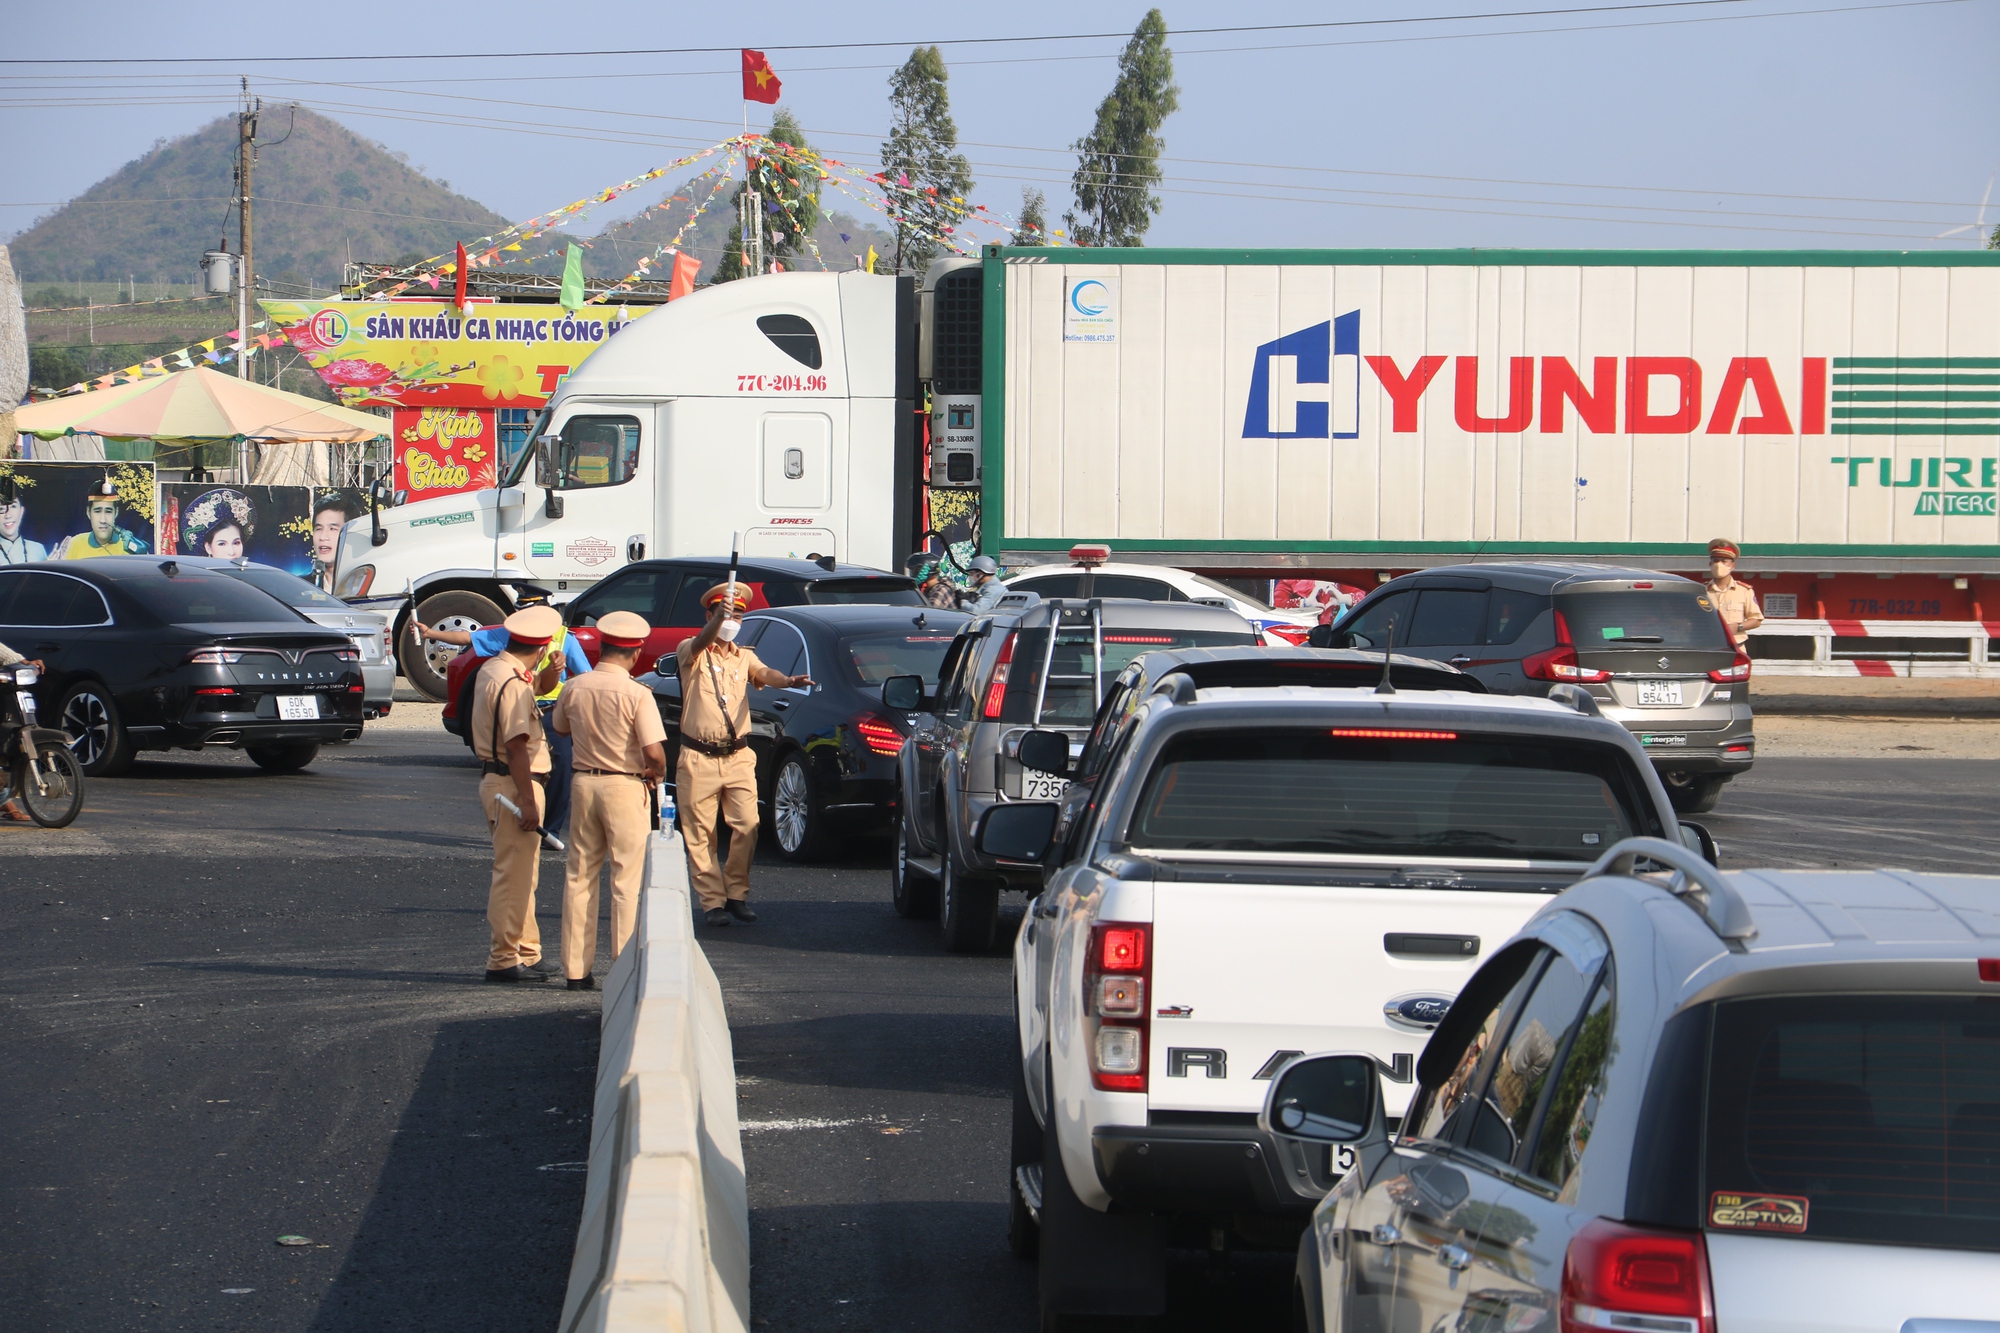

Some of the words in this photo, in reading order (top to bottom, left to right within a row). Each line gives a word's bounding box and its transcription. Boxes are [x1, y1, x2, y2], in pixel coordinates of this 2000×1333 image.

[366, 312, 403, 340] SÂN
[409, 310, 460, 339] KHẤU
[465, 318, 491, 340] CA
[495, 317, 547, 346] NHẠC
[552, 310, 604, 341] TỔNG
[1242, 309, 1827, 438] HYUNDAI
[737, 375, 827, 391] 77C-204.96
[405, 448, 469, 490] Chào
[1849, 599, 1941, 615] 77R-032.09
[258, 672, 334, 680] VINFAST
[1650, 681, 1669, 691] 51H
[288, 697, 305, 707] 60K
[1643, 692, 1677, 703] 954.17
[285, 708, 314, 718] 165.90
[1642, 735, 1686, 744] enterprise
[1713, 1209, 1803, 1225] CAPTIVA
